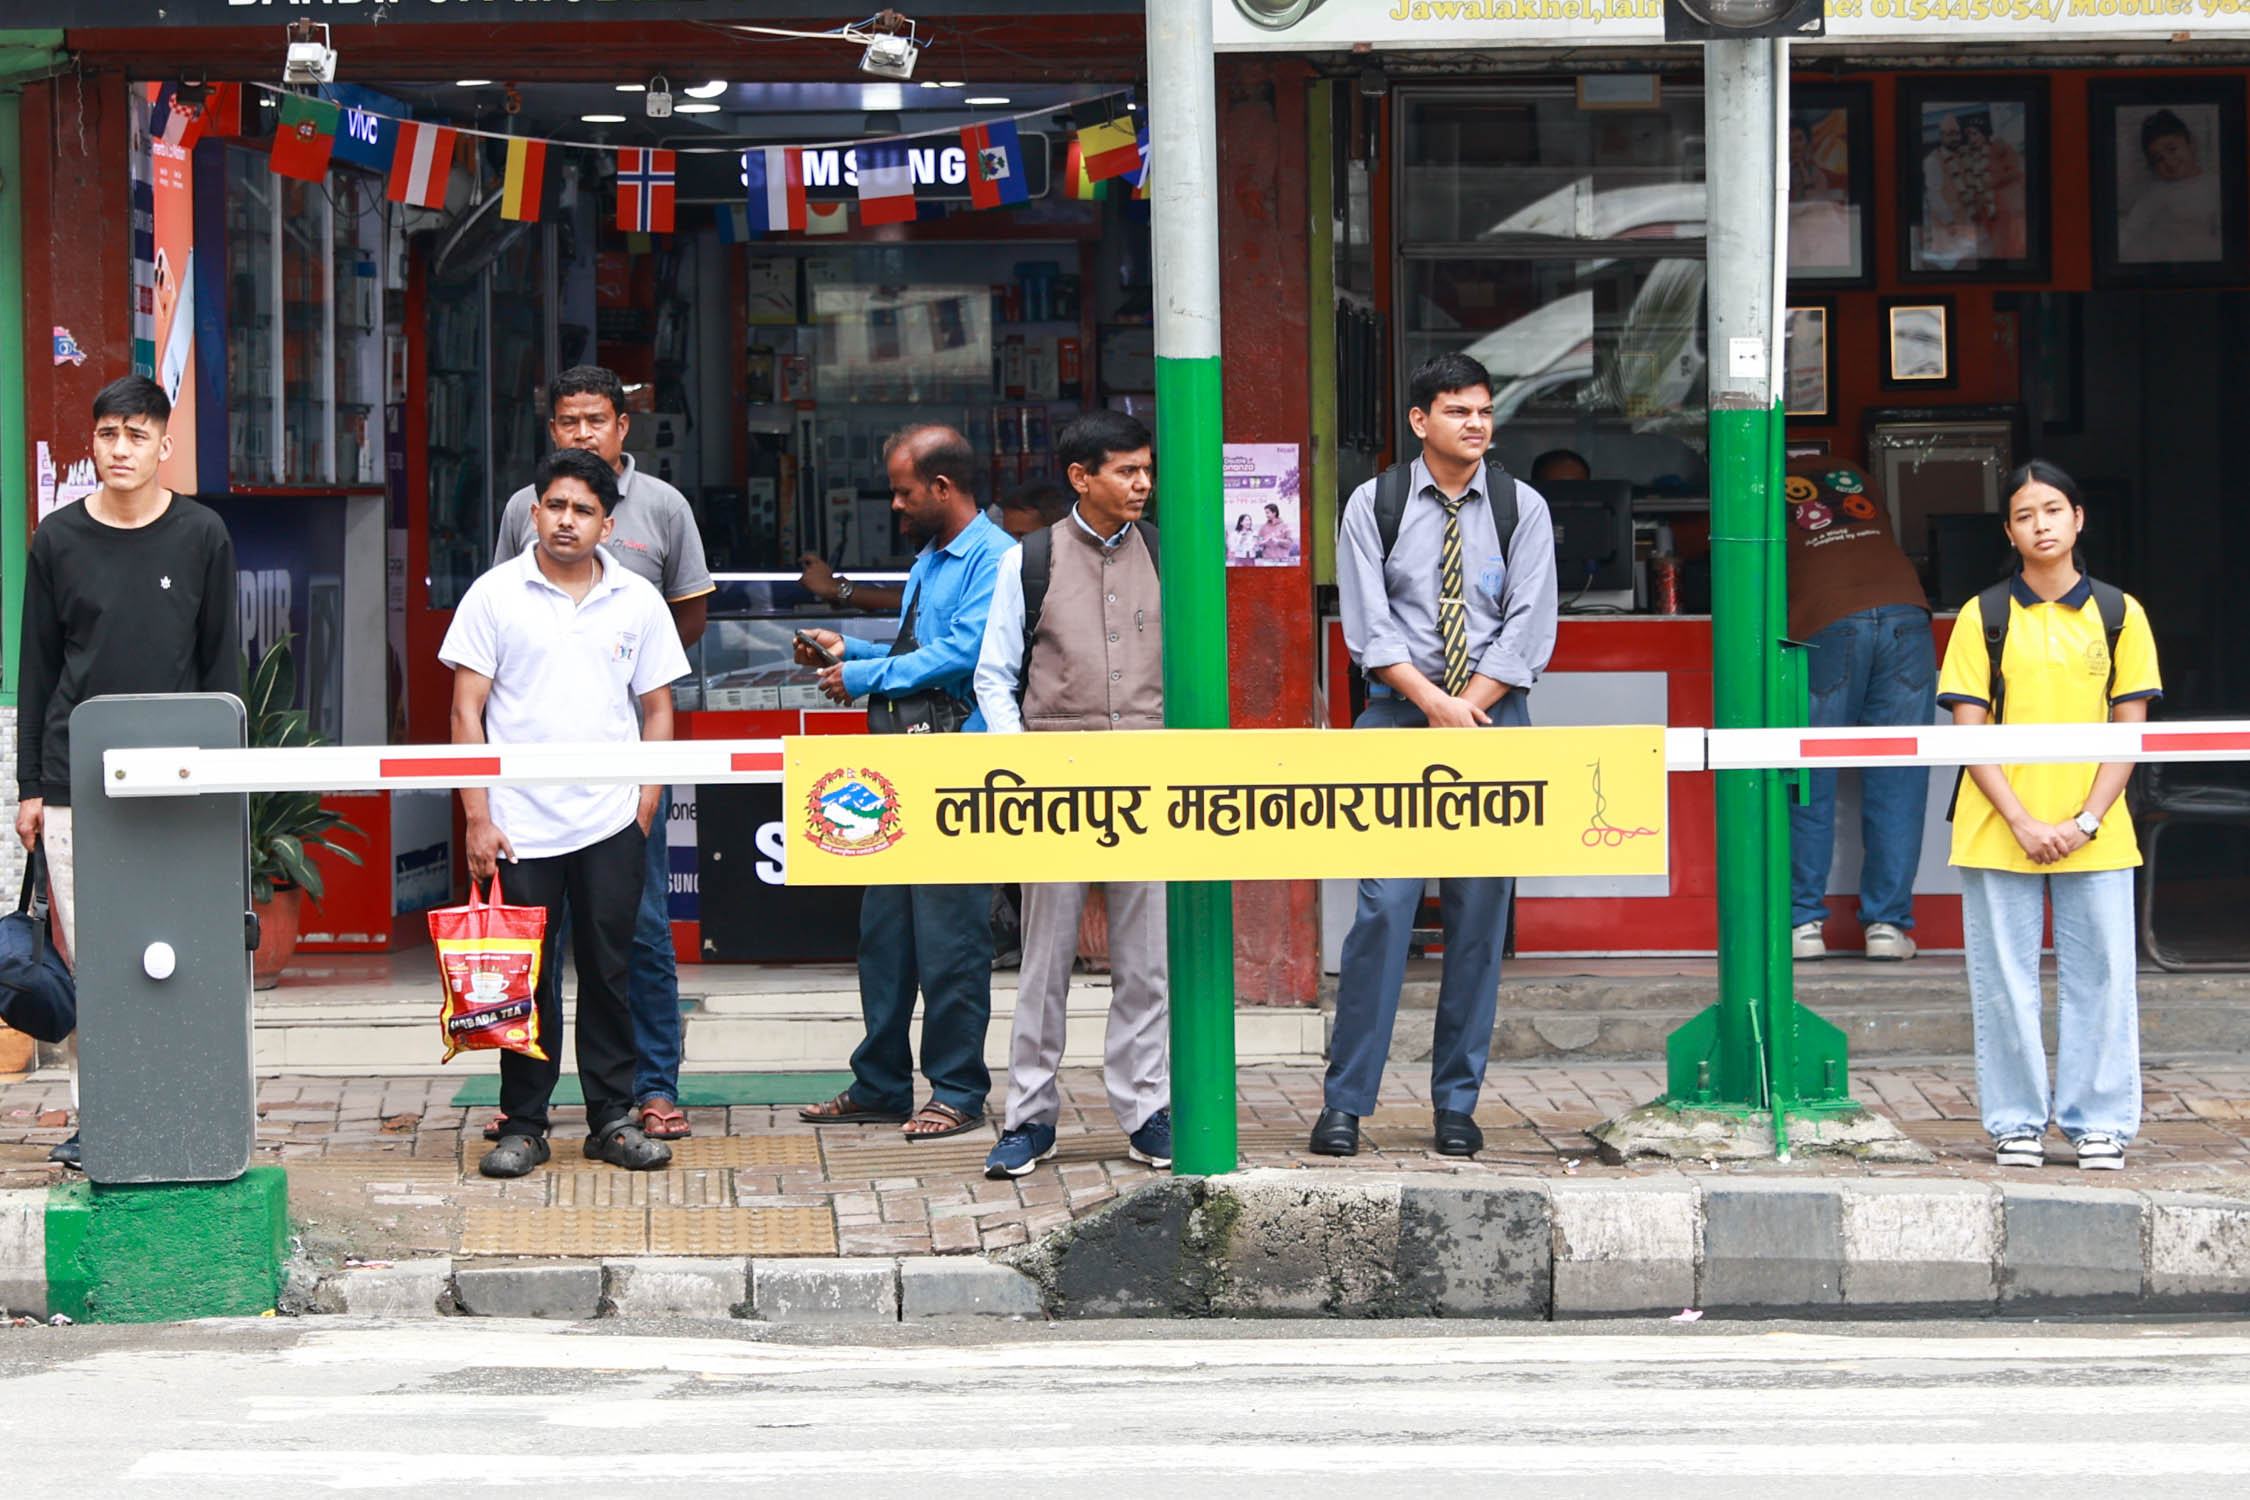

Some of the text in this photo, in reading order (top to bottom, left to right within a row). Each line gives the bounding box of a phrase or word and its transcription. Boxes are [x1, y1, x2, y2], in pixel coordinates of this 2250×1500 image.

[740, 147, 967, 187] SMSUNG
[236, 569, 292, 663] PUR
[935, 763, 1548, 848] ललितपुर महानगरपालिका
[500, 1005, 522, 1019] TEA
